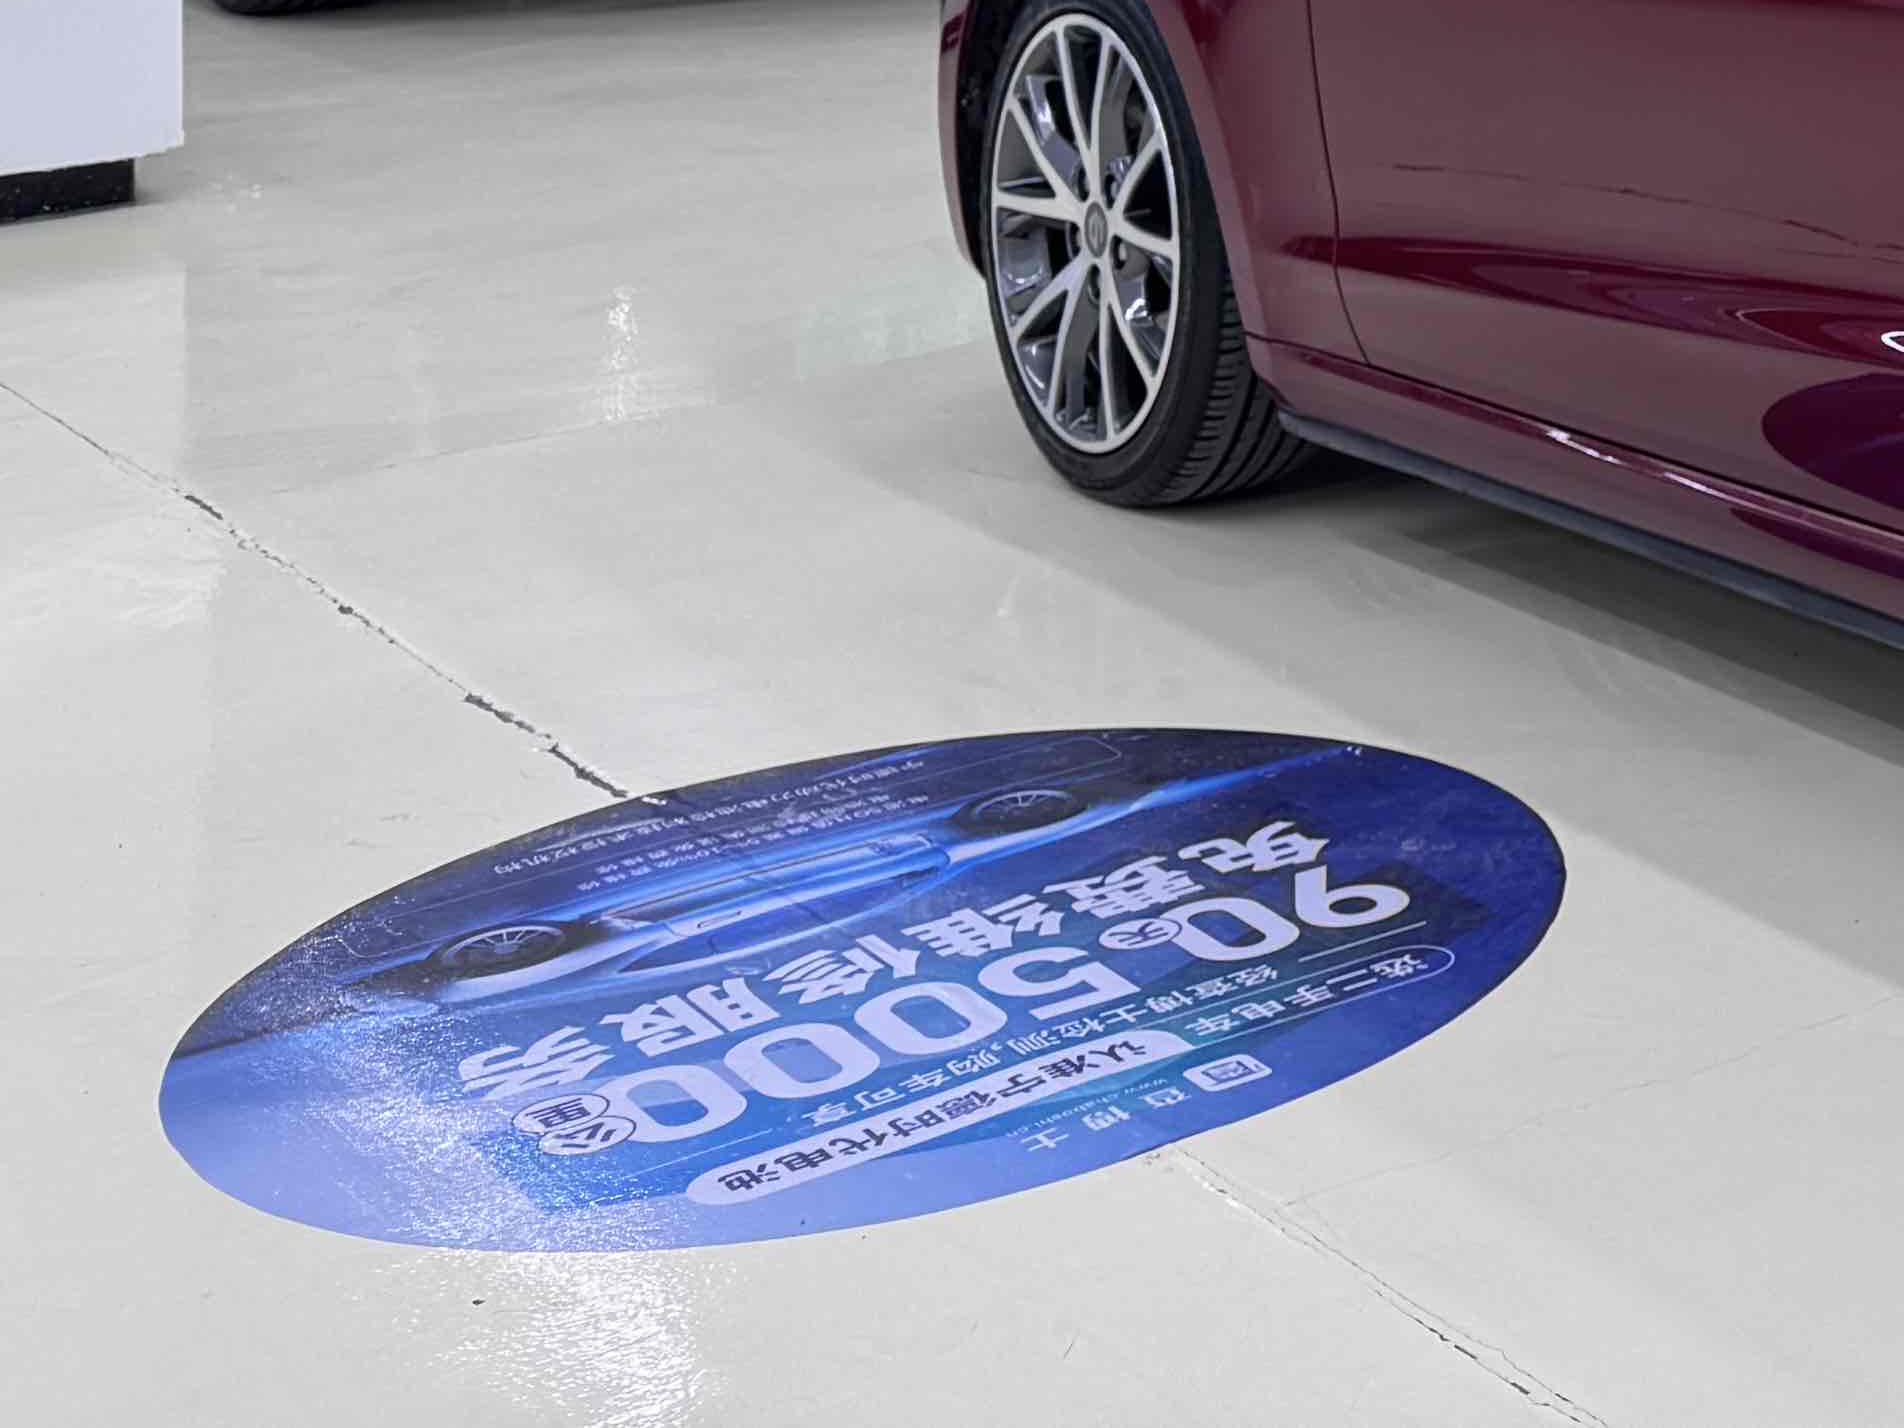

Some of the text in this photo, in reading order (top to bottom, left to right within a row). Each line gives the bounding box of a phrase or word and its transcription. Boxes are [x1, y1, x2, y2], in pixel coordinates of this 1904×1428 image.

[458, 821, 1330, 1102] 免费维修服务
[715, 953, 1428, 1193] 选二手电车 认准宁德时代电池
